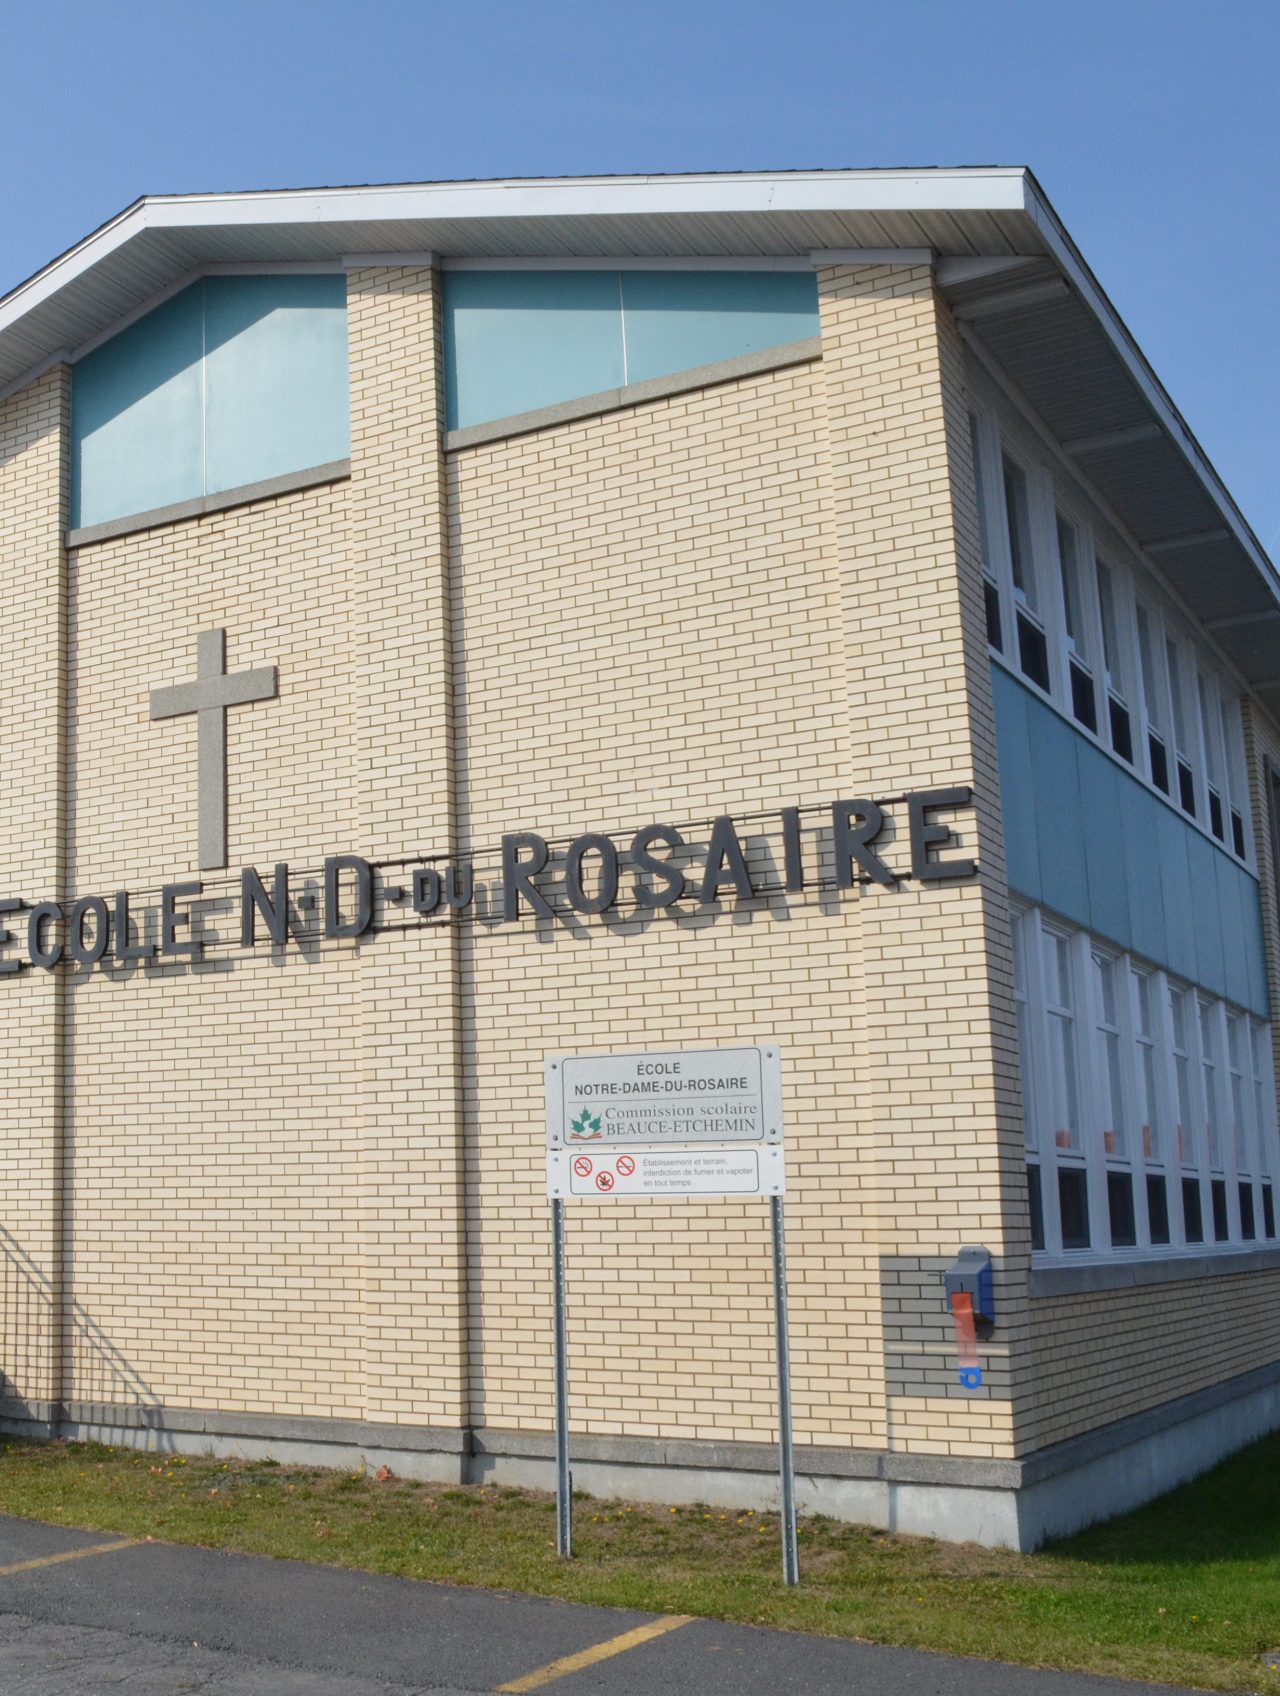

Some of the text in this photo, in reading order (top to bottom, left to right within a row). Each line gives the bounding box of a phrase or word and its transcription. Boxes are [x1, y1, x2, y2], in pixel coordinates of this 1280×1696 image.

[501, 786, 978, 922] ROSAIRE
[637, 1061, 681, 1076] ÉCOLE
[575, 1077, 748, 1096] NOTRE-DAME-DU-ROSAIRE
[605, 1102, 758, 1120] Commission scolaire
[606, 1118, 756, 1136] BEAUCE-ETCHEMIN
[726, 1168, 753, 1177] vapoter
